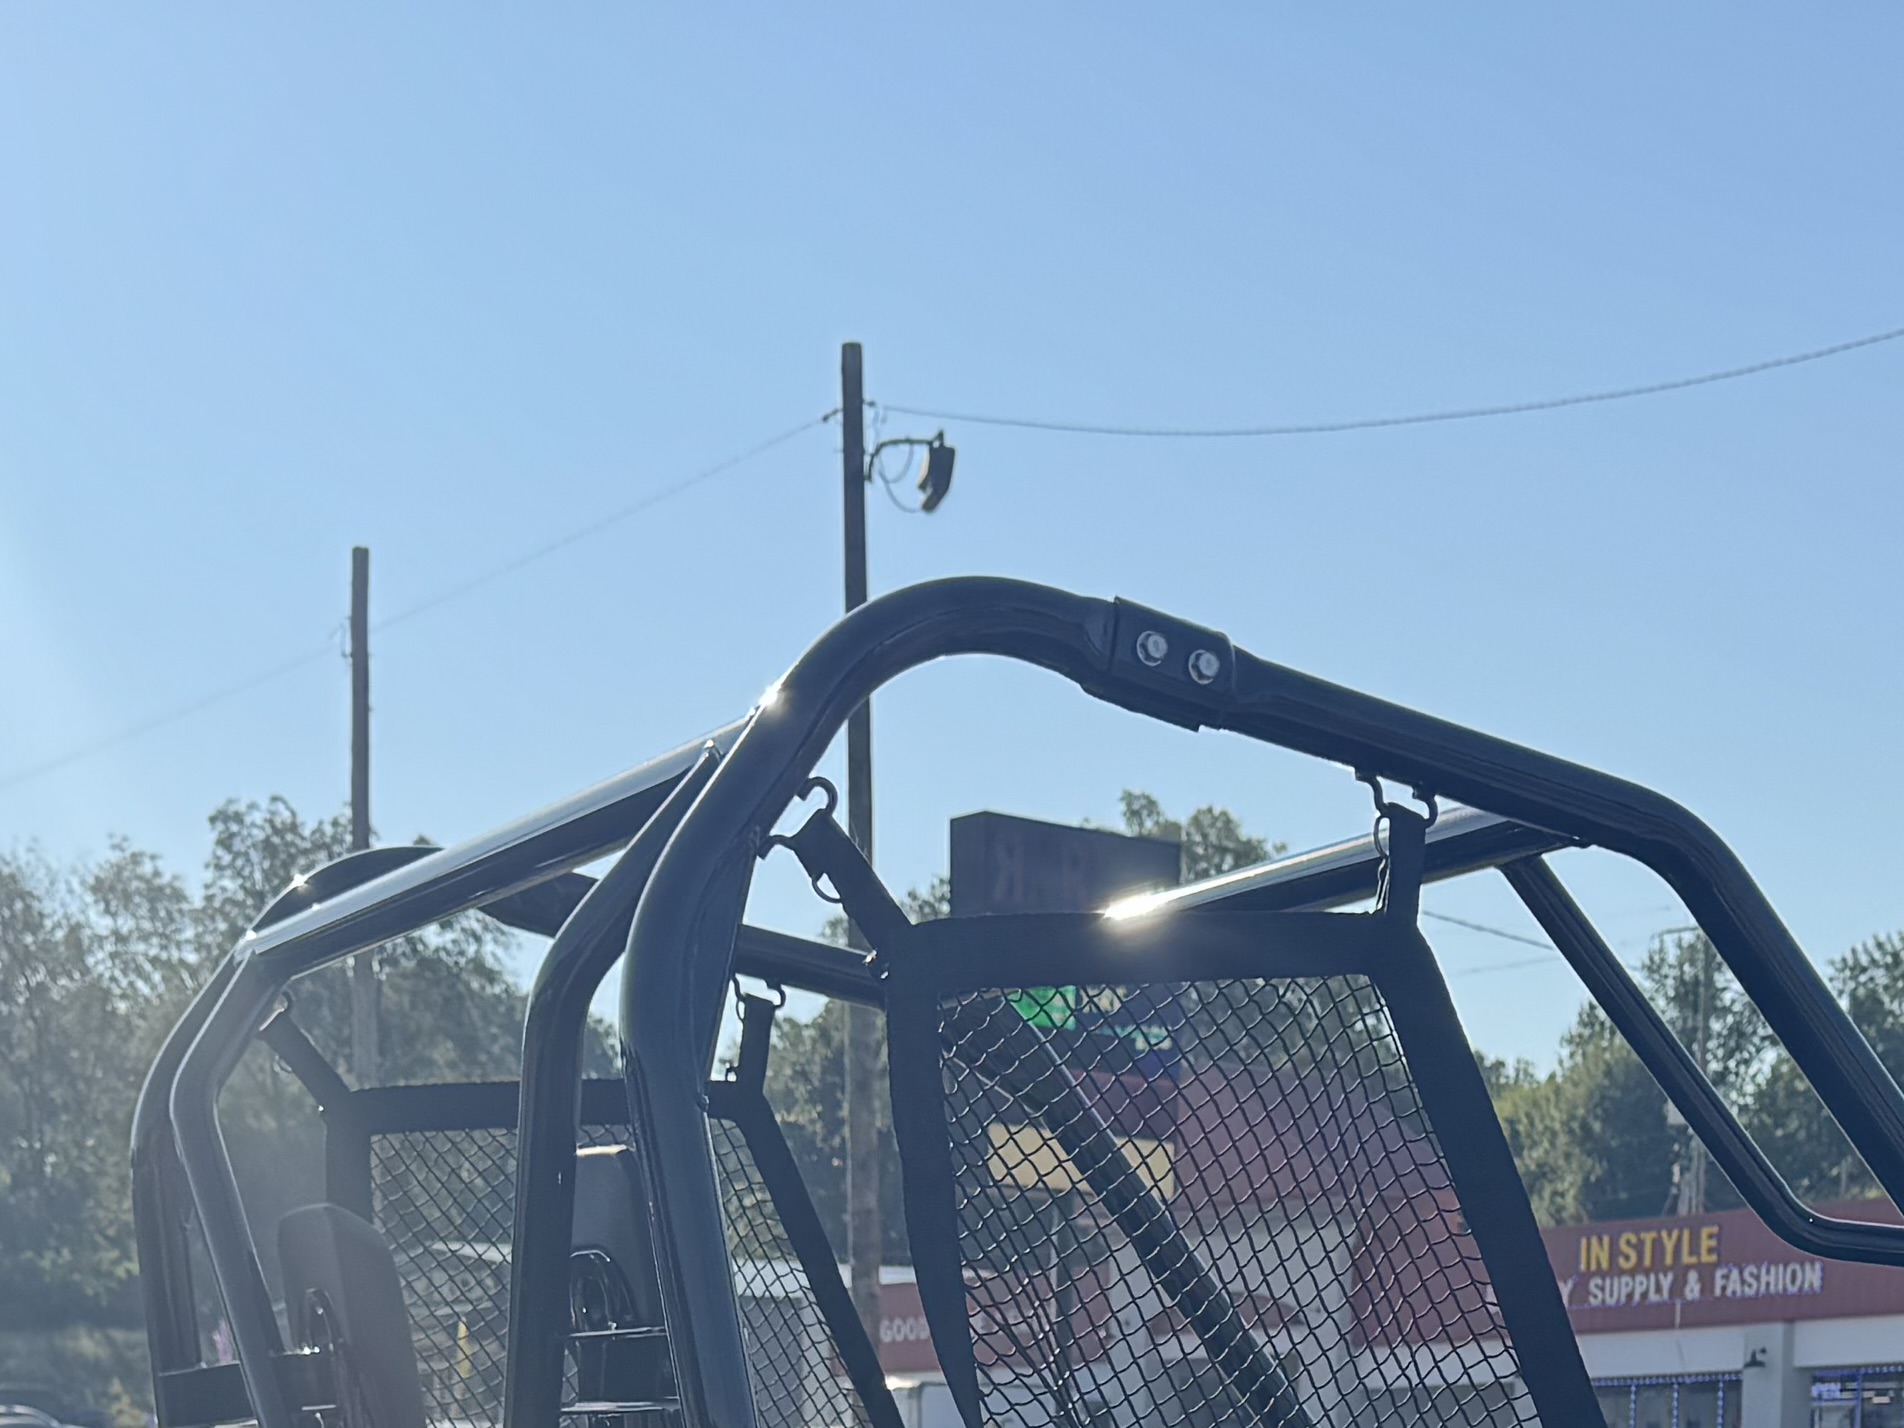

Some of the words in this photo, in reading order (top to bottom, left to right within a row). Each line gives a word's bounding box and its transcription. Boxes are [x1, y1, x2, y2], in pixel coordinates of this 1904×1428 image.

[1580, 1235, 1609, 1271] IN
[1618, 1225, 1719, 1270] STYLE
[1589, 1271, 1674, 1306] SUPPLY
[1684, 1271, 1701, 1300] &
[1714, 1261, 1822, 1297] FASHION
